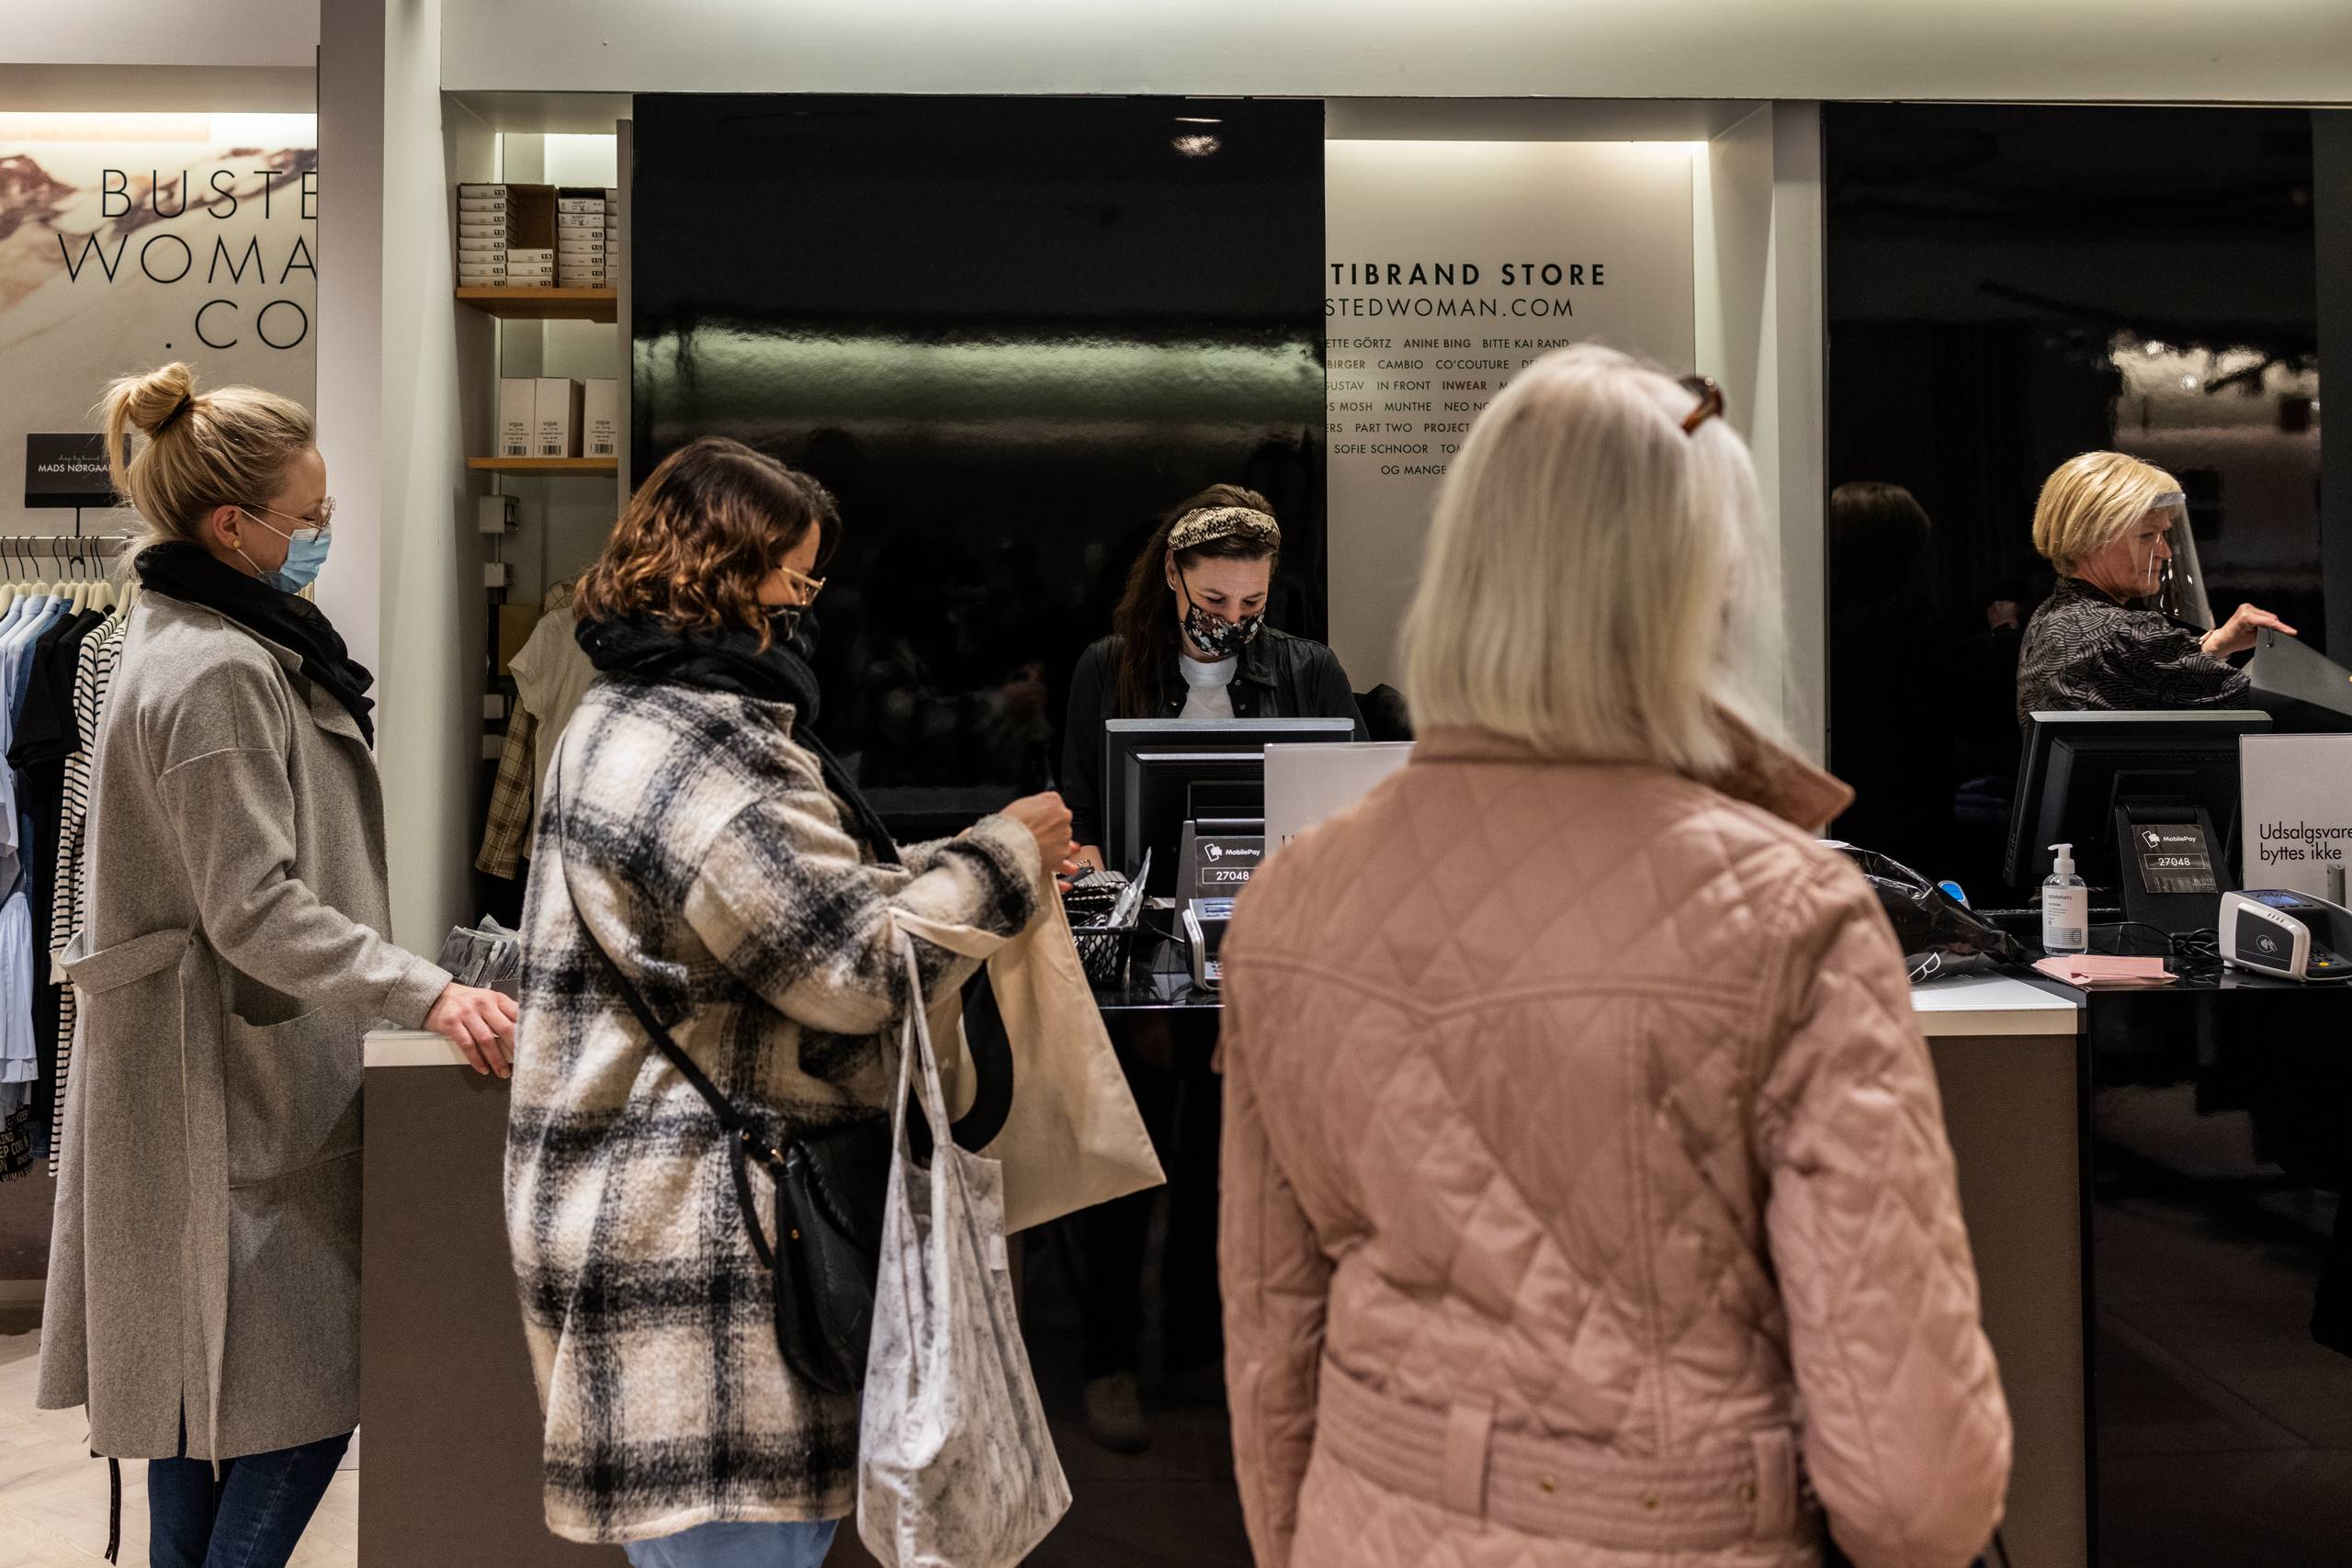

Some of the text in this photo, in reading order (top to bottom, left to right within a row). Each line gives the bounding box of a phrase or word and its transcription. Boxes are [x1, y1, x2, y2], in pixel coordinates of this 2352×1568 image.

[102, 169, 317, 220] BUSTE
[57, 233, 317, 285] WOMA
[1330, 263, 1604, 287] TIBRAND STORE
[1353, 336, 1392, 349] GÖRTZ
[1404, 339, 1471, 348] ANINE BING
[1483, 339, 1569, 348] BITTE KAI RAND
[1328, 360, 1365, 369] BIRGER
[1378, 360, 1424, 369] CAMBIO
[1377, 381, 1431, 390] IN FRONT
[1442, 381, 1487, 390] INWEAR
[1340, 402, 1373, 412] MOSH
[1385, 402, 1432, 412] MUNTHE
[1443, 402, 1469, 412] NEO
[1355, 423, 1413, 433] PART TWO
[1424, 423, 1470, 433] PROJECT
[1334, 445, 1429, 454] SOFIE SCHNOOR
[38, 464, 65, 472] MADS
[1381, 466, 1447, 475] OG MANGE
[1225, 848, 1261, 856] MobilePay
[2260, 841, 2342, 865] byttes ikke
[2158, 857, 2191, 866] 27048
[1216, 871, 1250, 881] 27048
